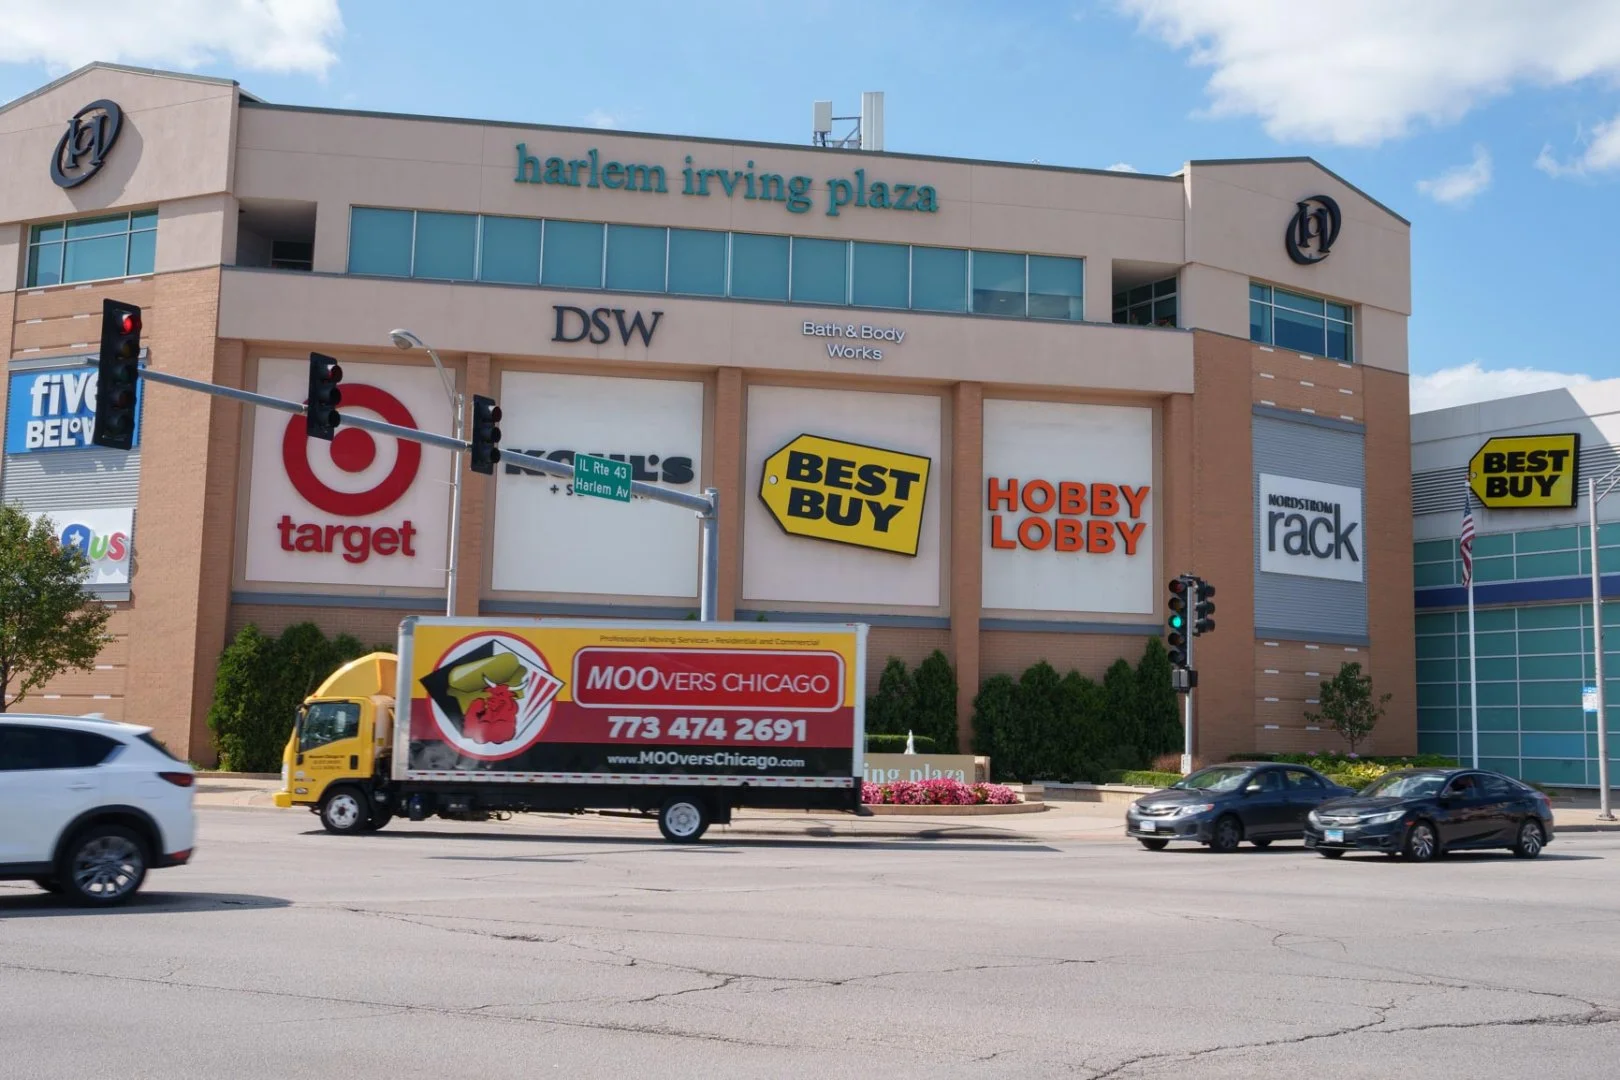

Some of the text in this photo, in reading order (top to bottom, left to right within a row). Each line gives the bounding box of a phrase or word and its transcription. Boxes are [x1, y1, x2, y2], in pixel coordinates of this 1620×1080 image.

[514, 143, 939, 216] harlem irving plaza
[551, 305, 664, 348] DSW
[803, 321, 905, 344] Bath & Body
[827, 343, 882, 360] Works
[579, 458, 627, 479] IL Rte 43
[1483, 450, 1569, 474] BEST
[575, 477, 612, 495] Harlem
[616, 485, 629, 498] Av
[786, 450, 920, 501] BEST
[1486, 474, 1561, 498] BUY
[787, 487, 904, 533] BUY
[988, 477, 1151, 519] HOBBY
[1268, 493, 1334, 514] NORDSTROM
[277, 515, 417, 564] target
[991, 515, 1147, 556] LOBBY
[1268, 503, 1360, 562] rack
[722, 674, 830, 694] CHICAGO
[608, 716, 807, 742] 773 474 2691
[607, 751, 805, 770] www.MOOversChicago.com
